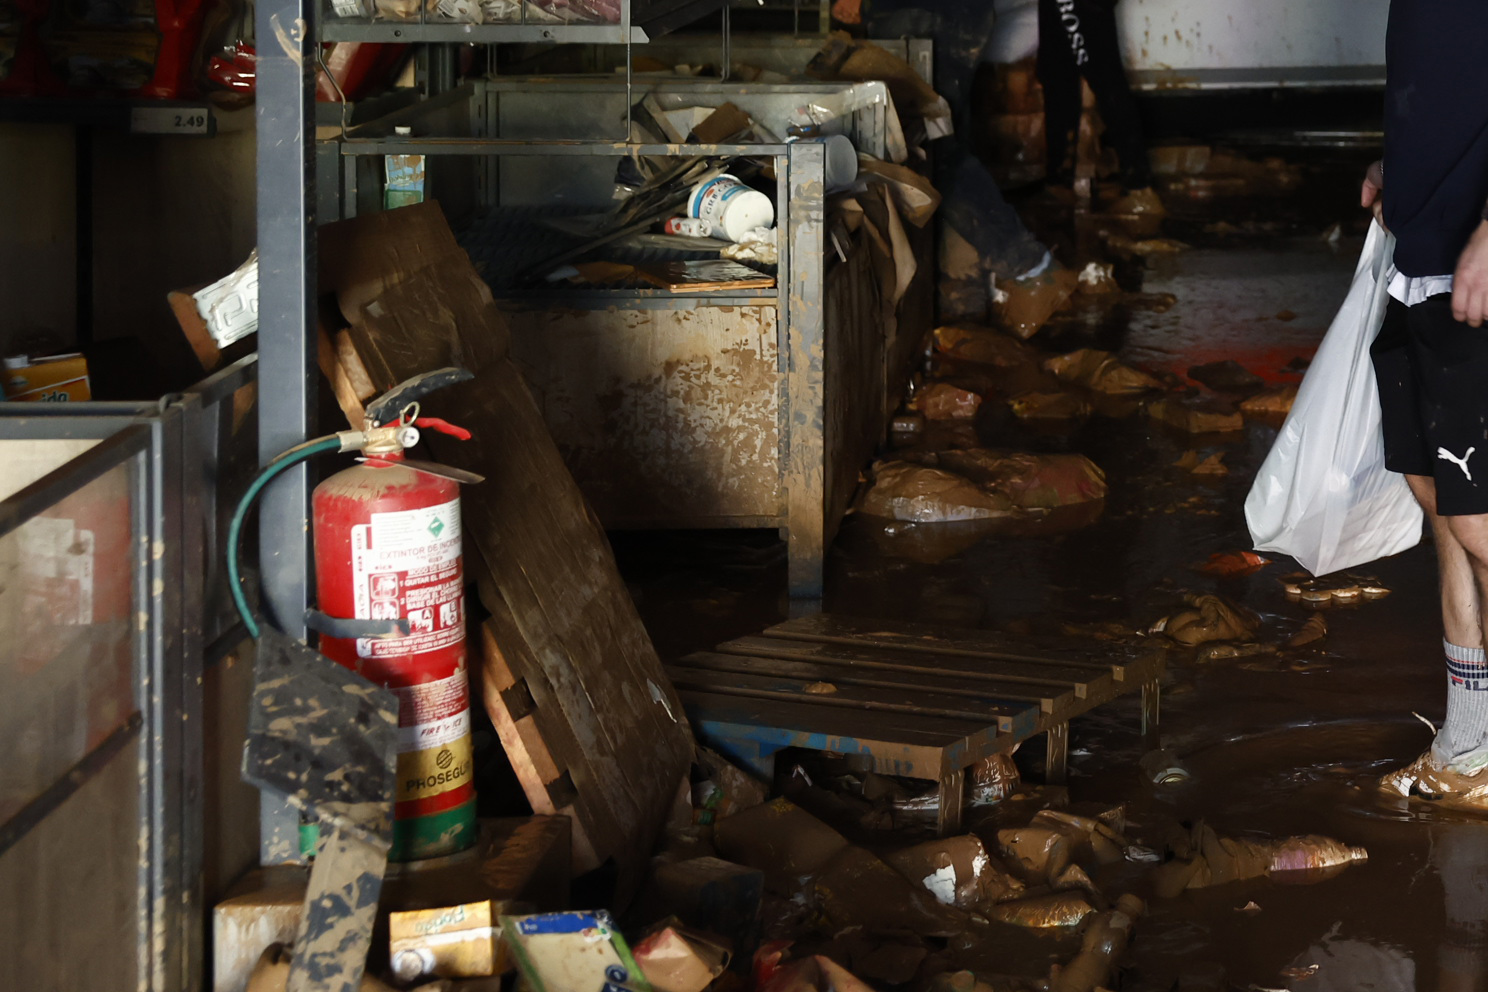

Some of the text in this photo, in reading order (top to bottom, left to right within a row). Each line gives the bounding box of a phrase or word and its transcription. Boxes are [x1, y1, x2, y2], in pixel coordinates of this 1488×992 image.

[175, 116, 204, 128] 2.49
[380, 546, 426, 560] EXTINTOR
[427, 543, 440, 553] DE
[420, 724, 440, 737] FIRE
